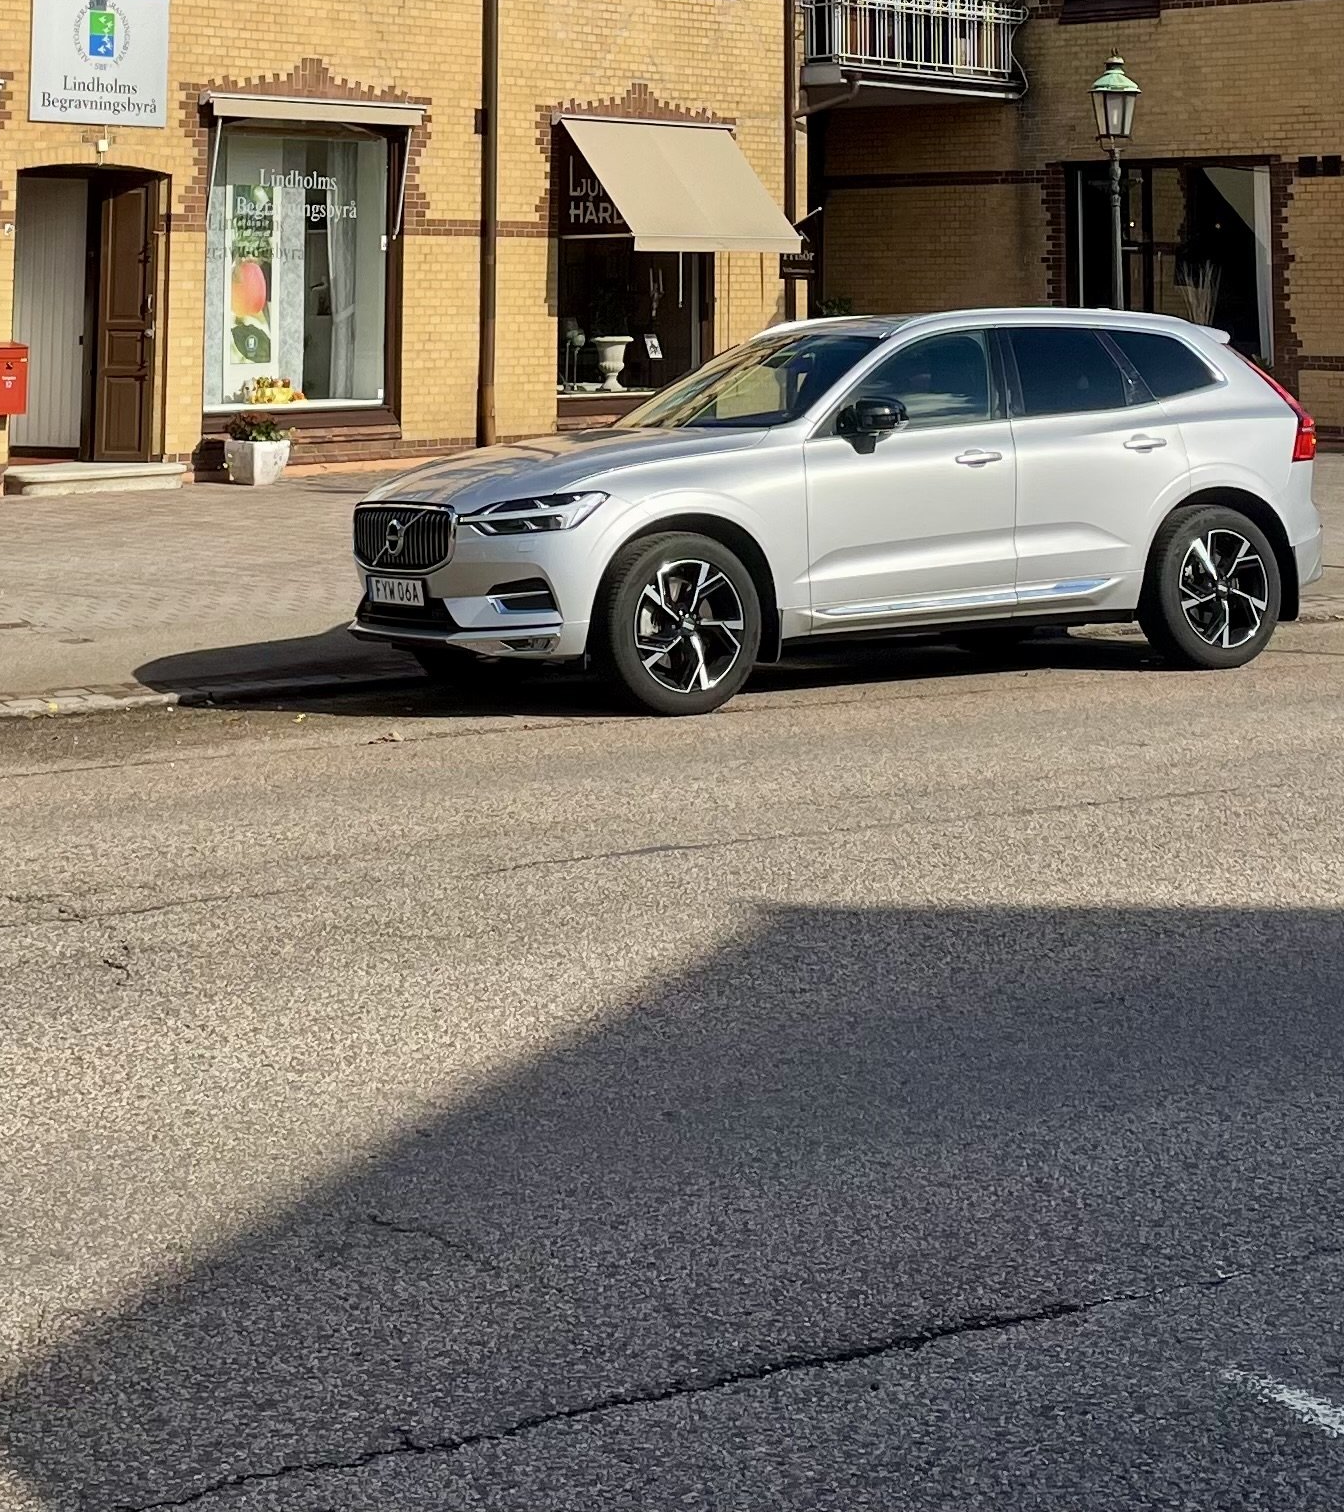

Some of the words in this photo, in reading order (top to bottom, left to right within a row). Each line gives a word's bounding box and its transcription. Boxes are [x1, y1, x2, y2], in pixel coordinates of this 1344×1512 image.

[63, 75, 138, 95] Lindholms
[41, 91, 157, 117] Begravningsbyrå
[259, 169, 337, 190] Lindholms
[236, 196, 357, 222] Begrningsbyrå
[375, 579, 396, 601] FYW
[397, 581, 420, 603] 06A
